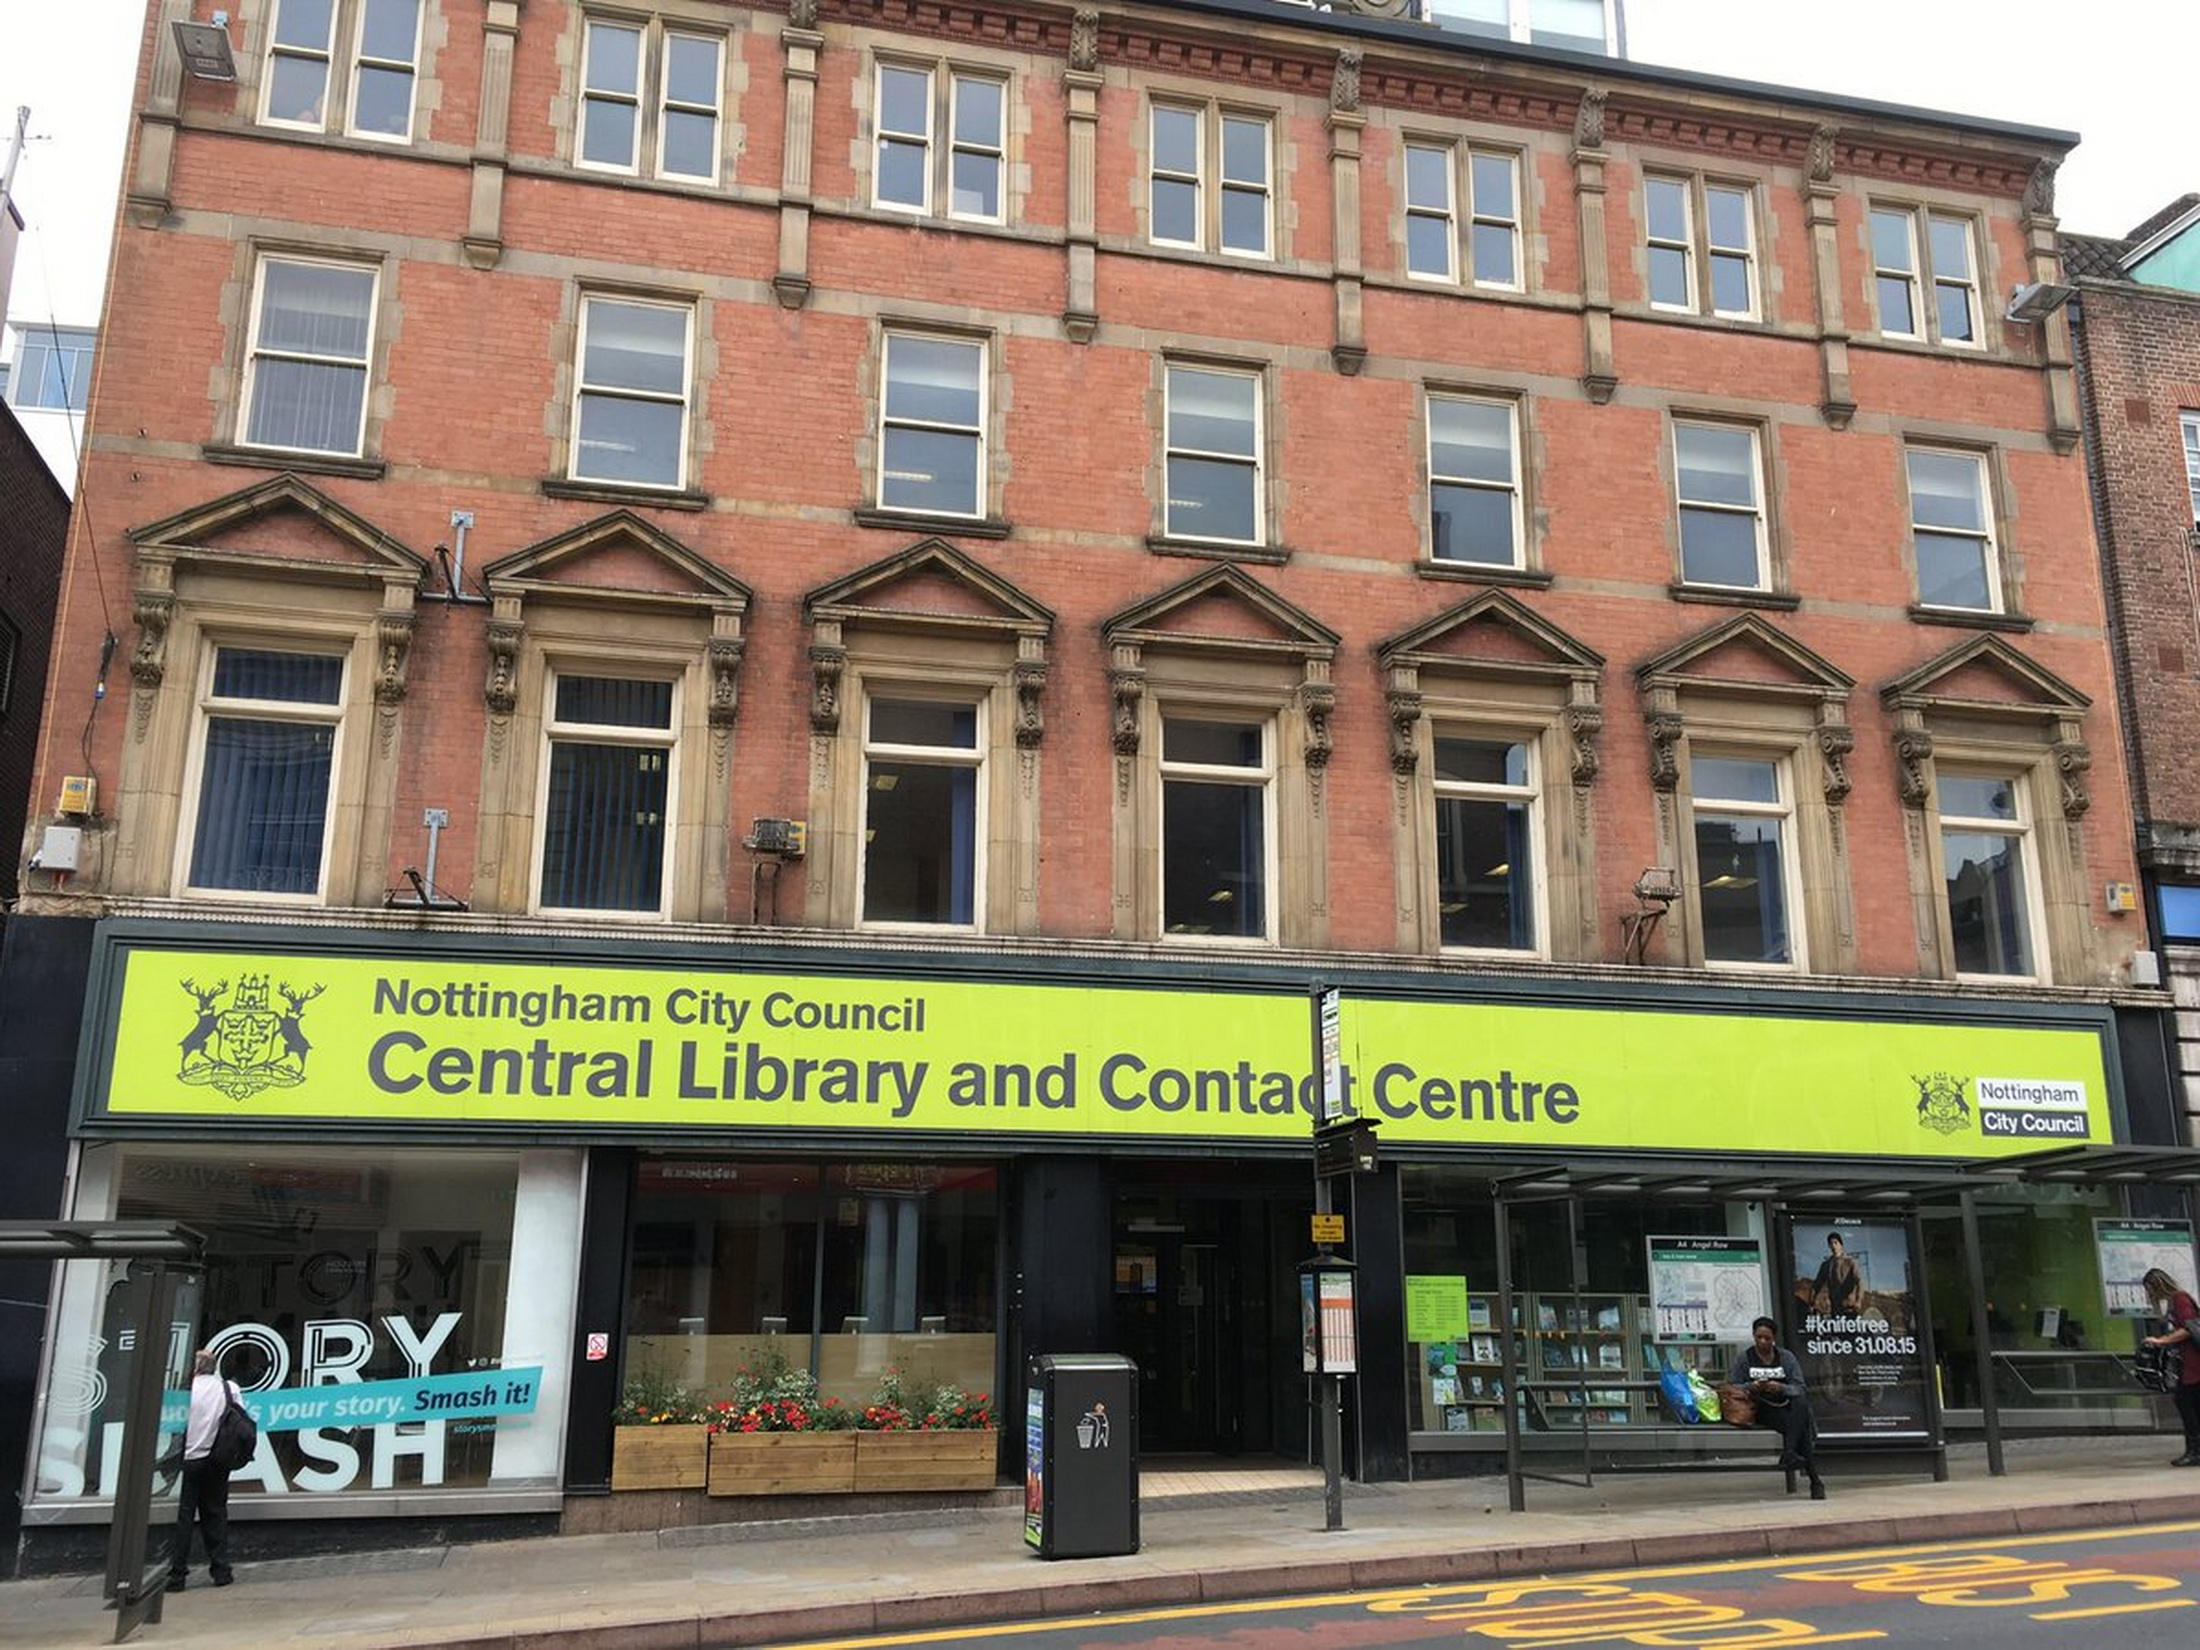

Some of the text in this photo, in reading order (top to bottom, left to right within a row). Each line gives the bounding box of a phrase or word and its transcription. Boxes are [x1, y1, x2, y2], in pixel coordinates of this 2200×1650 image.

[374, 978, 925, 1034] Nottingham City Council
[368, 1031, 653, 1098] Central
[678, 1040, 929, 1118] Library
[948, 1052, 1076, 1109] and
[1373, 1062, 1580, 1124] Centre
[1981, 1082, 2079, 1104] Nottingham
[1984, 1112, 2085, 1133] City Council
[1805, 1313, 1889, 1334] #knifefree
[1807, 1336, 1917, 1354] since 31.08.15
[266, 1400, 329, 1427] your
[333, 1394, 405, 1419] story.
[414, 1383, 498, 1411] Smash
[504, 1381, 531, 1405] it!
